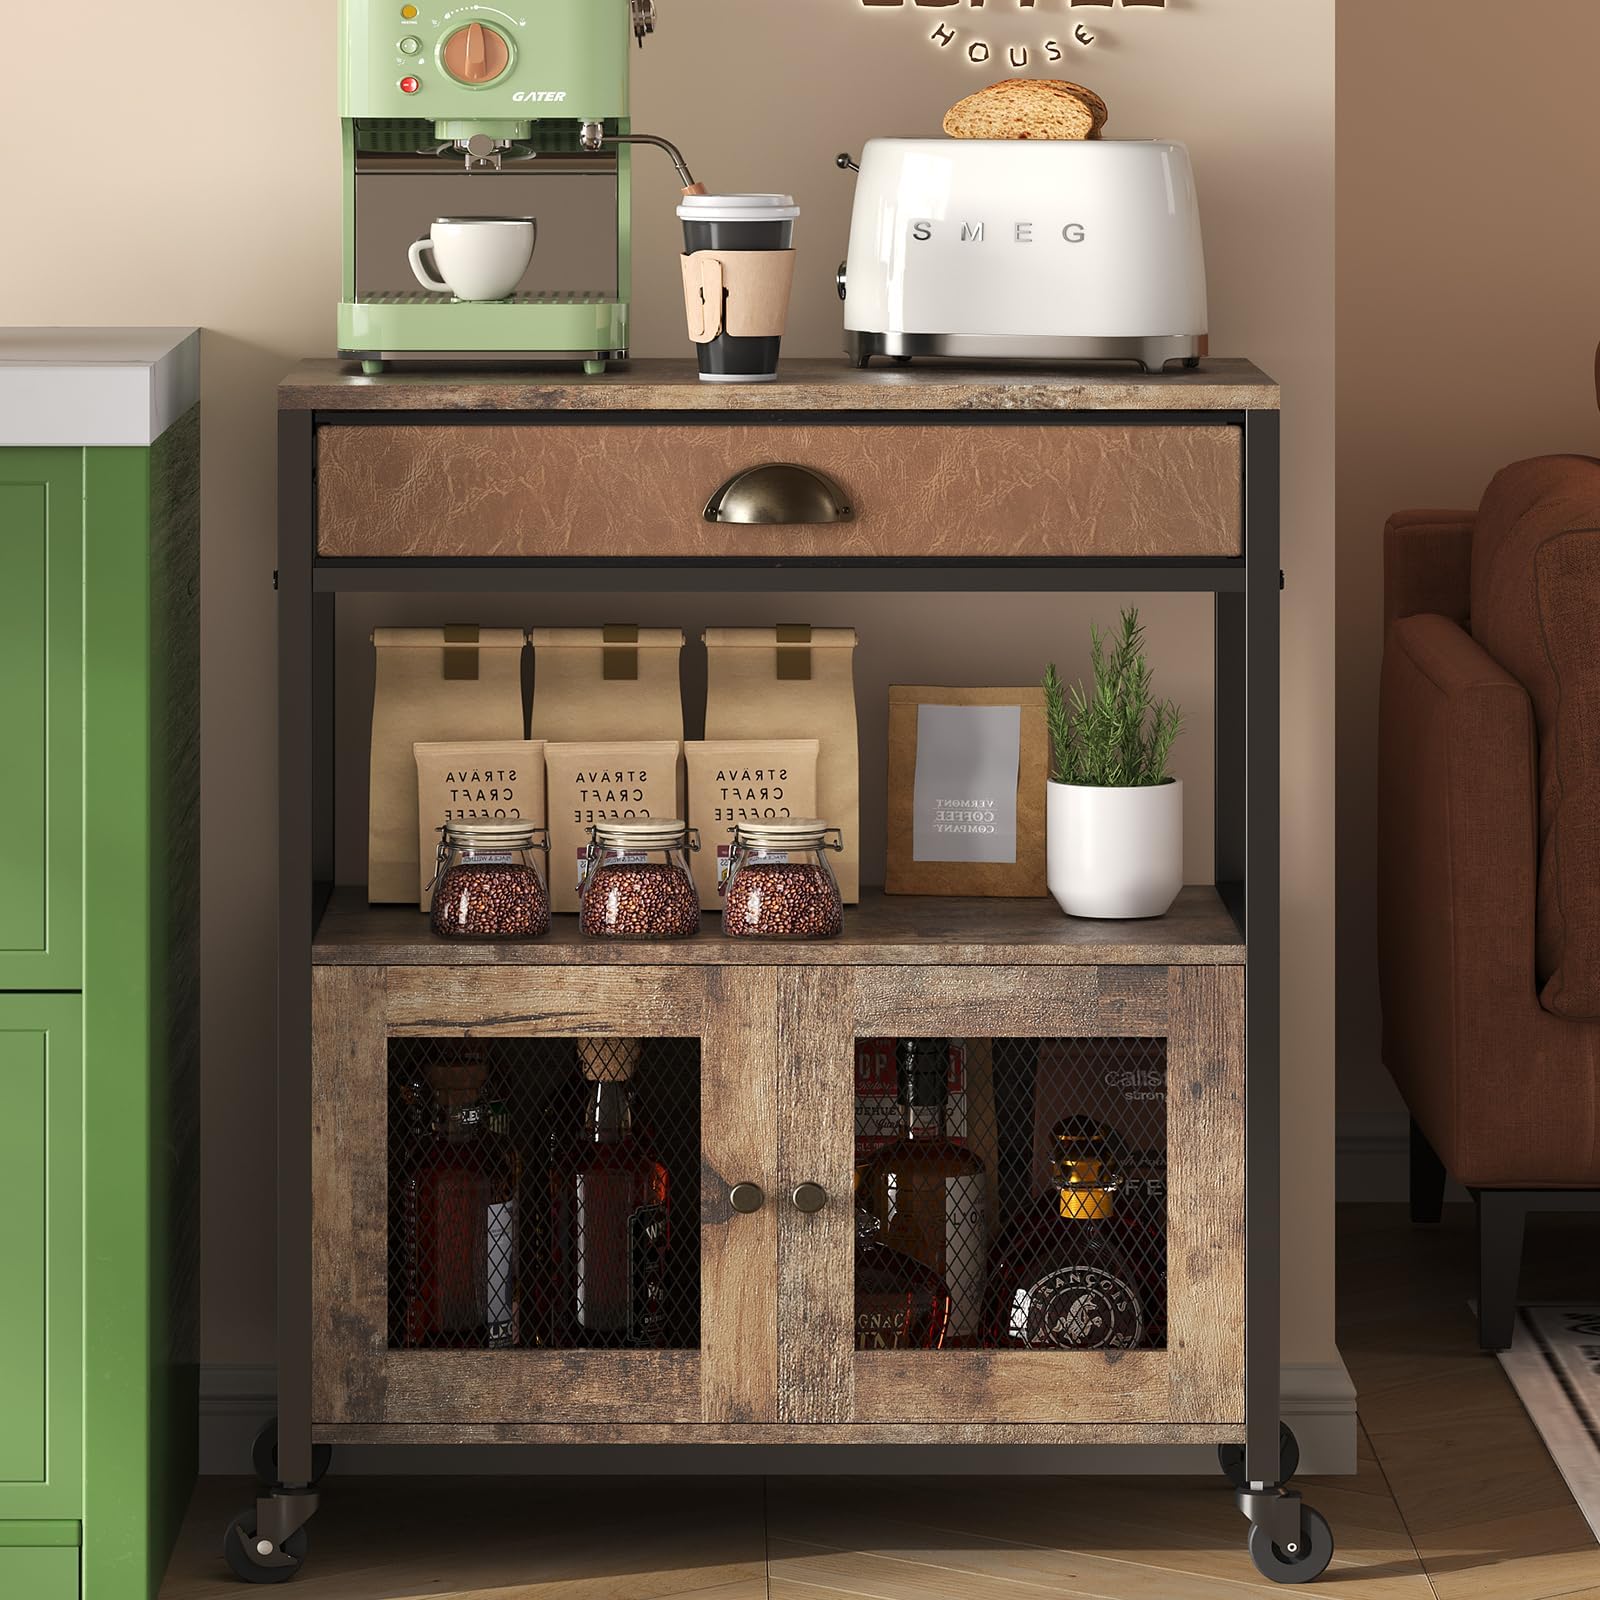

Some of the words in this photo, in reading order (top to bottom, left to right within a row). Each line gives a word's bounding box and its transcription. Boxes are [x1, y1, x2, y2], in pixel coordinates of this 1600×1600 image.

[931, 22, 1095, 67] HOUSE
[512, 91, 567, 102] GATER
[912, 221, 1086, 244] SMEG
[1125, 1091, 1166, 1101] stron
